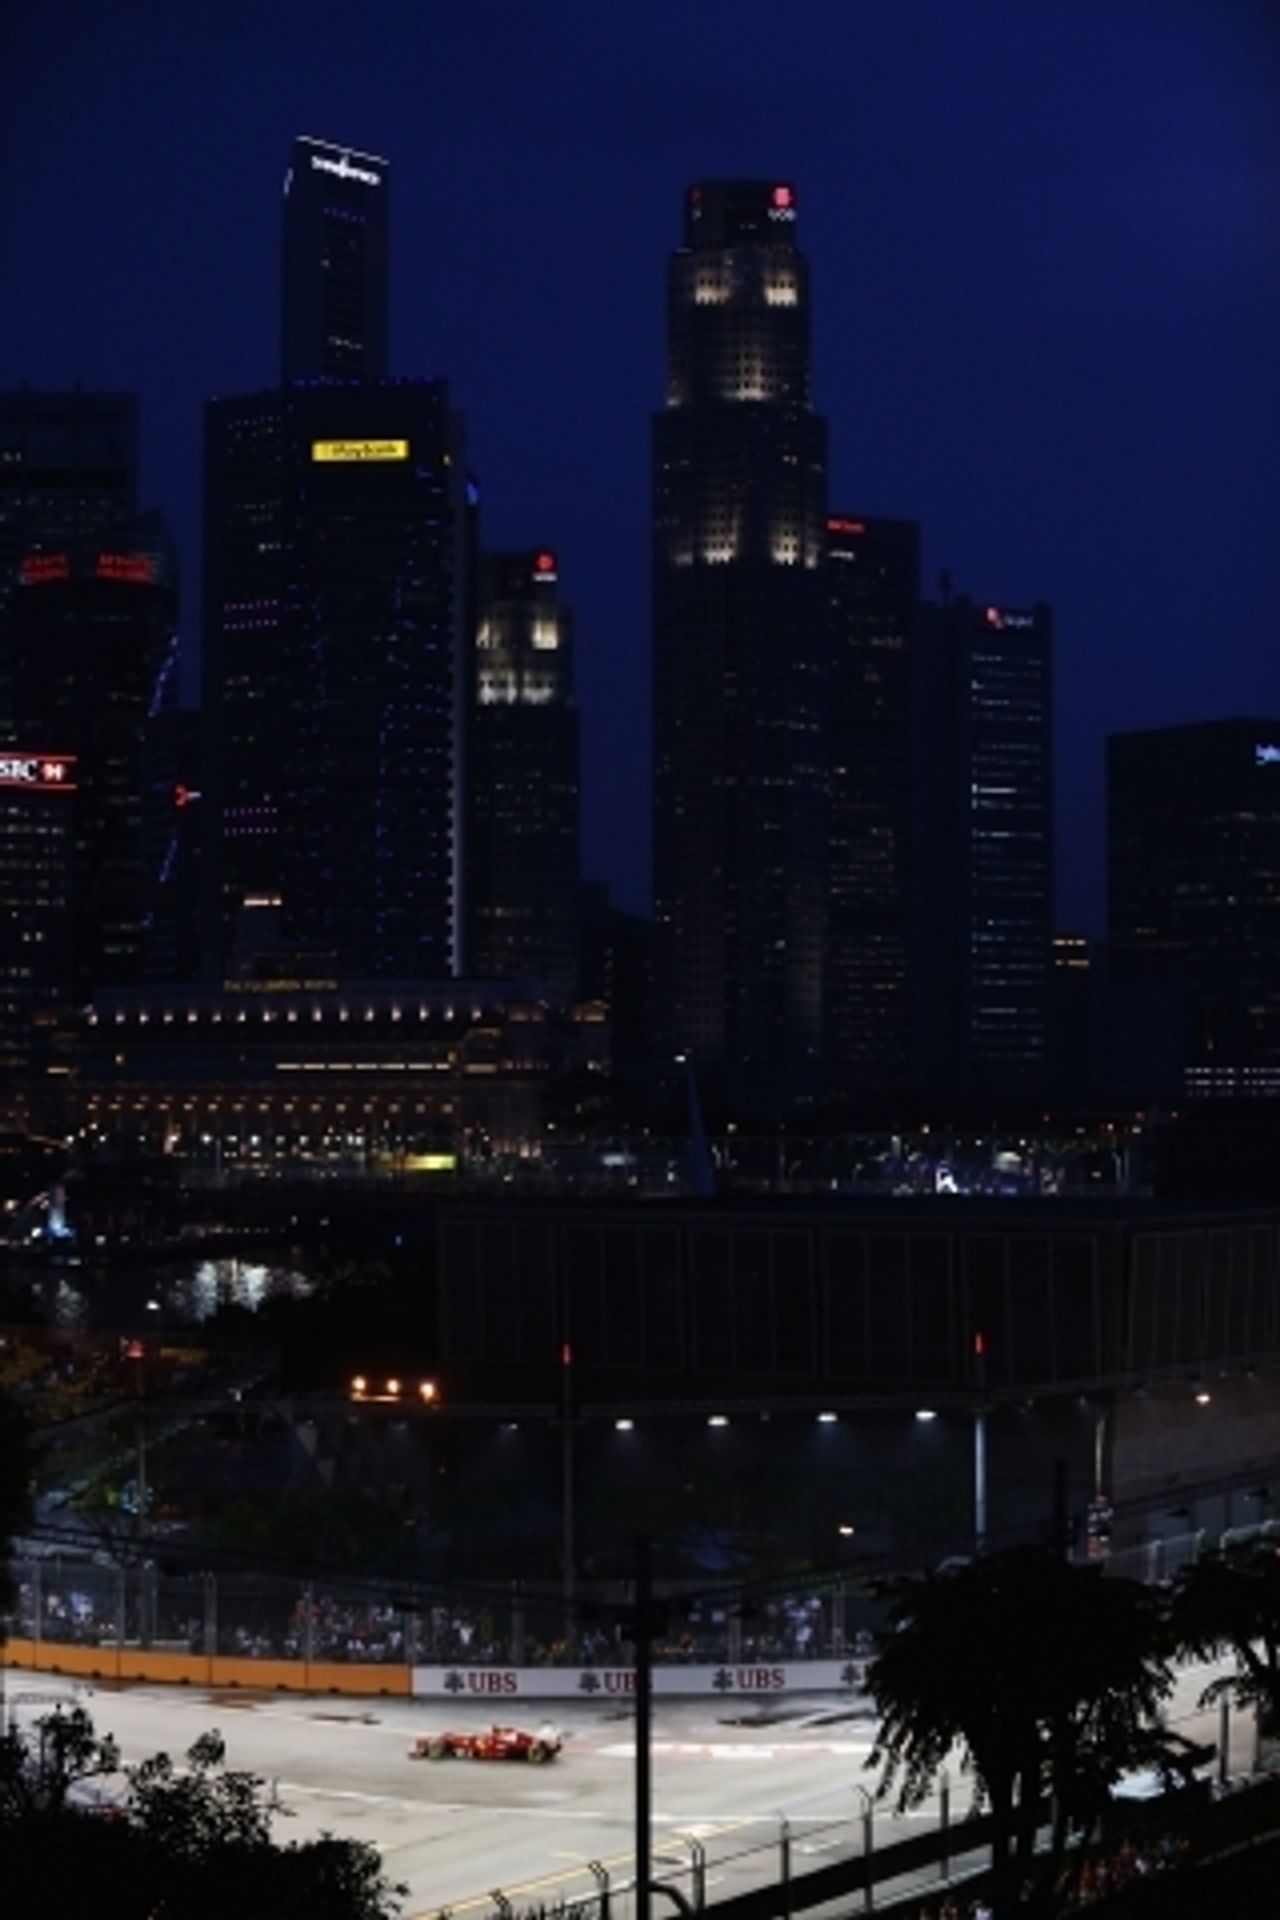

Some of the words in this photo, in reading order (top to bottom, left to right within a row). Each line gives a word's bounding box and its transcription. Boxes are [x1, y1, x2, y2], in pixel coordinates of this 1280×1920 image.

[467, 1671, 518, 1693] UBS
[603, 1671, 638, 1693] UB
[736, 1667, 786, 1690] UBS
